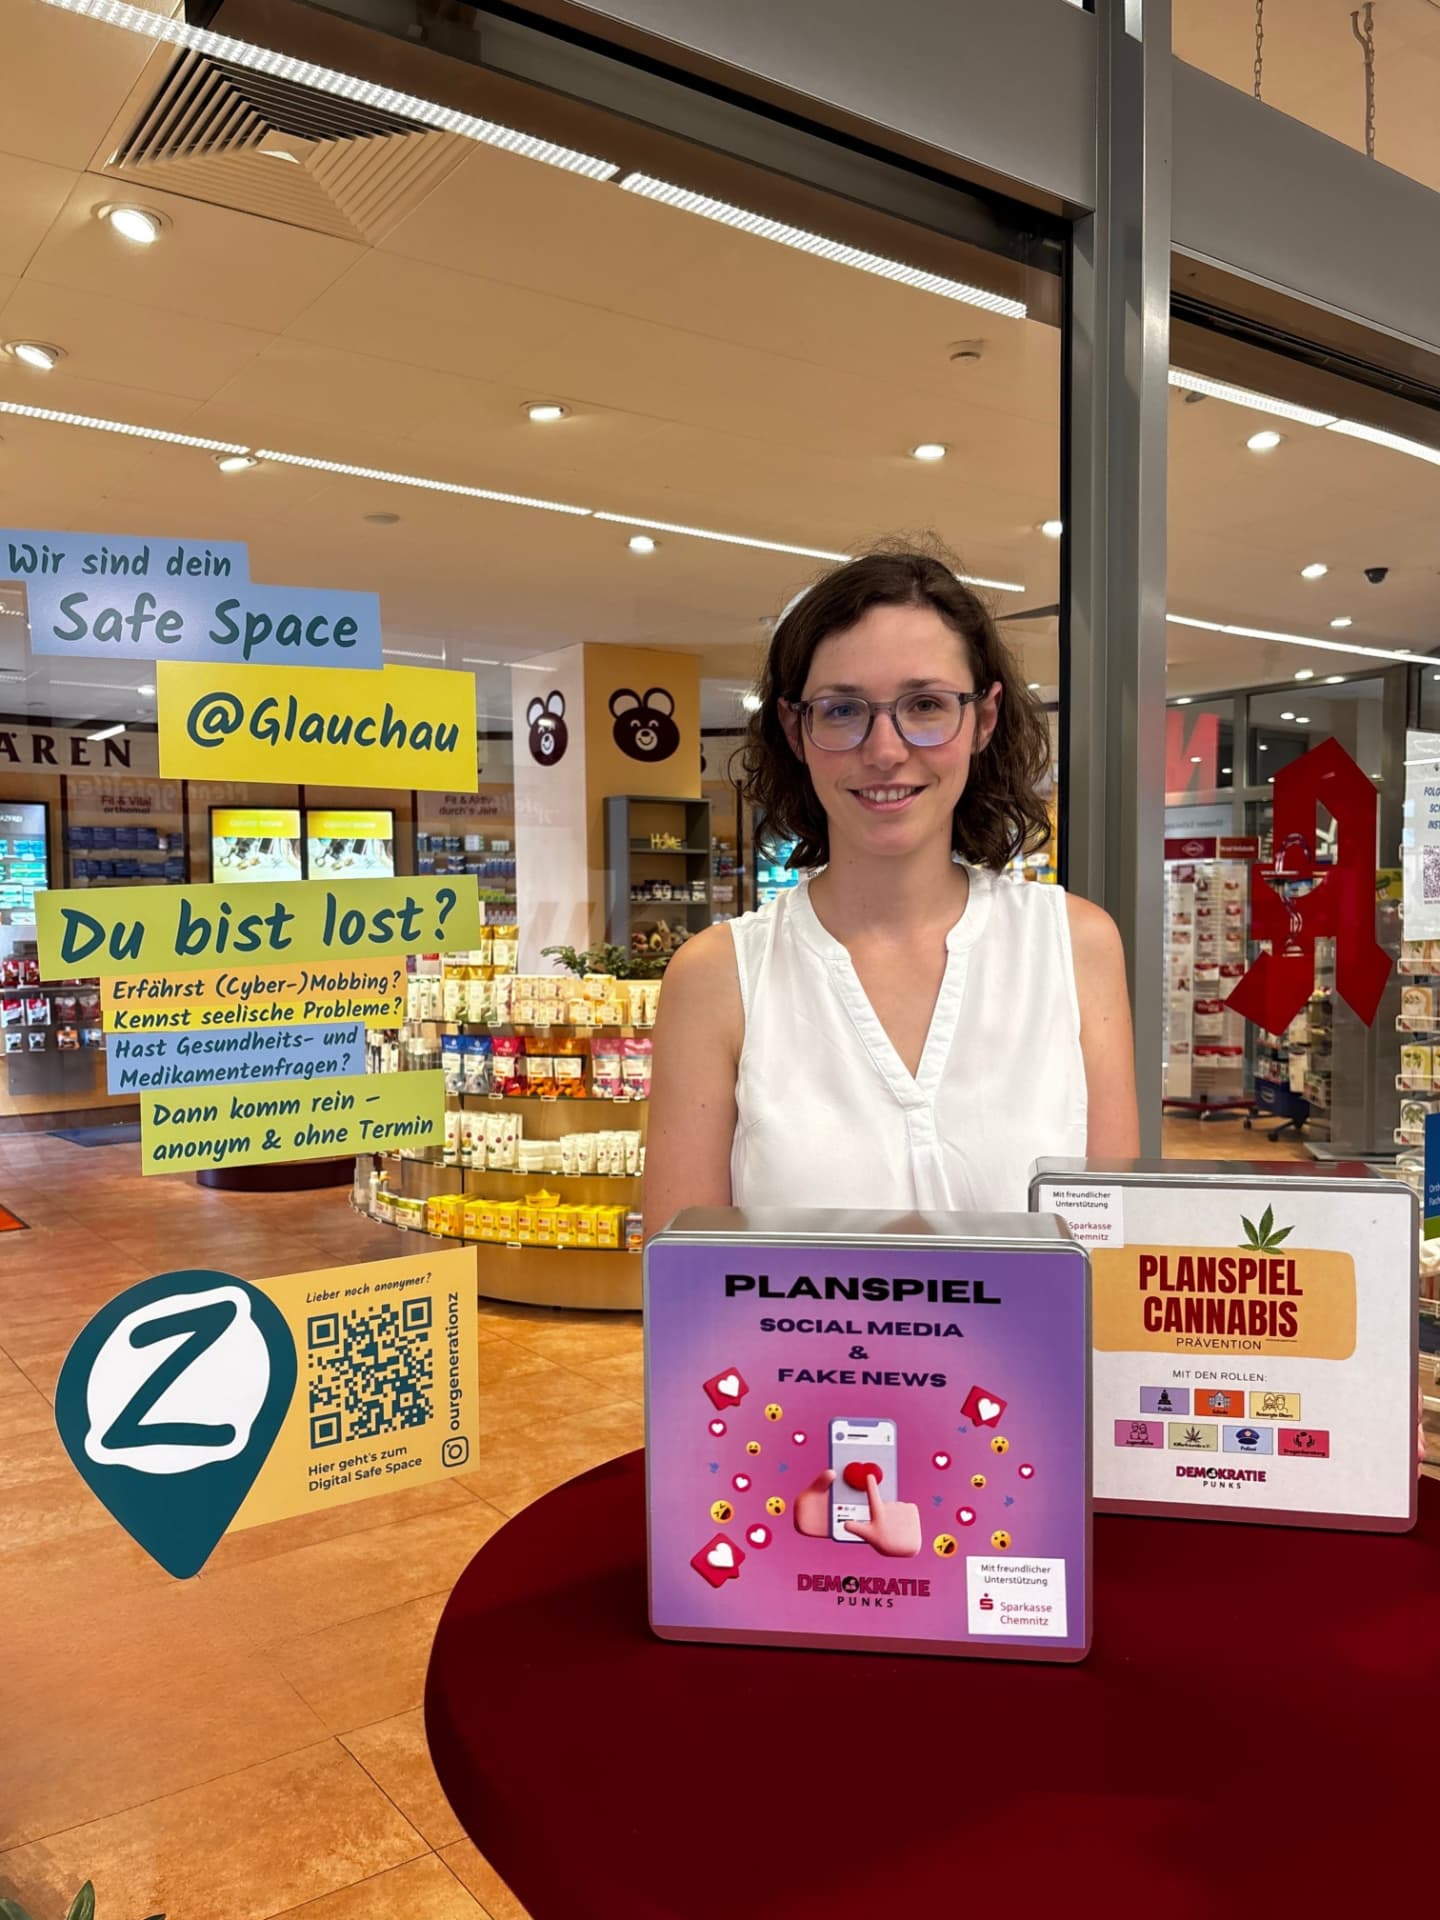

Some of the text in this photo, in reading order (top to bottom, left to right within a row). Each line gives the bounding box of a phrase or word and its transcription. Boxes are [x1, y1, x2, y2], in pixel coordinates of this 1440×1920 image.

[8, 544, 232, 577] Wir sind dein
[53, 592, 358, 661] Safe Space
[187, 691, 459, 752] @Glauchau
[60, 887, 457, 964] Du bist lost?
[112, 970, 401, 1000] Erfährst (Cyber-)Mobbing?
[113, 996, 402, 1029] Kennst seelische Probleme?
[115, 1026, 358, 1059] Hast Gesundheits- und
[119, 1053, 350, 1089] Medikamentenfragen?
[153, 1102, 218, 1127] Dann
[229, 1096, 301, 1120] komm
[311, 1091, 354, 1113] rein
[153, 1114, 433, 1162] anonym & ohne Termin
[1053, 1190, 1111, 1199] Mit freundlicher
[1055, 1200, 1109, 1209] Unterstützung
[1068, 1221, 1112, 1231] Sparkasse
[1073, 1232, 1109, 1241] hemnitz
[306, 1272, 432, 1304] Lieber noch anonymer?
[724, 1274, 1002, 1305] PLANSPIEL
[1138, 1254, 1303, 1296] PLANSPIEL
[760, 1318, 964, 1338] SOCIAL MEDIA
[1143, 1296, 1298, 1338] CANNABIS
[848, 1345, 869, 1360] &
[1176, 1336, 1262, 1351] PRÄVENTION
[445, 1291, 463, 1431] ourgenerationz
[778, 1368, 947, 1388] FAKE NEWS
[1172, 1370, 1267, 1383] MIT DEN ROLLEN:
[308, 1460, 334, 1477] Hier
[381, 1446, 407, 1460] zum
[308, 1457, 423, 1492] Digital Safe Space
[1202, 1480, 1242, 1490] PUNKS
[981, 1564, 1051, 1575] Mit freundlicher
[984, 1575, 1049, 1587] Unterstützung
[837, 1596, 894, 1608] PUNKS
[1000, 1601, 1053, 1614] Sparkasse
[1000, 1614, 1050, 1627] Chemnitz
